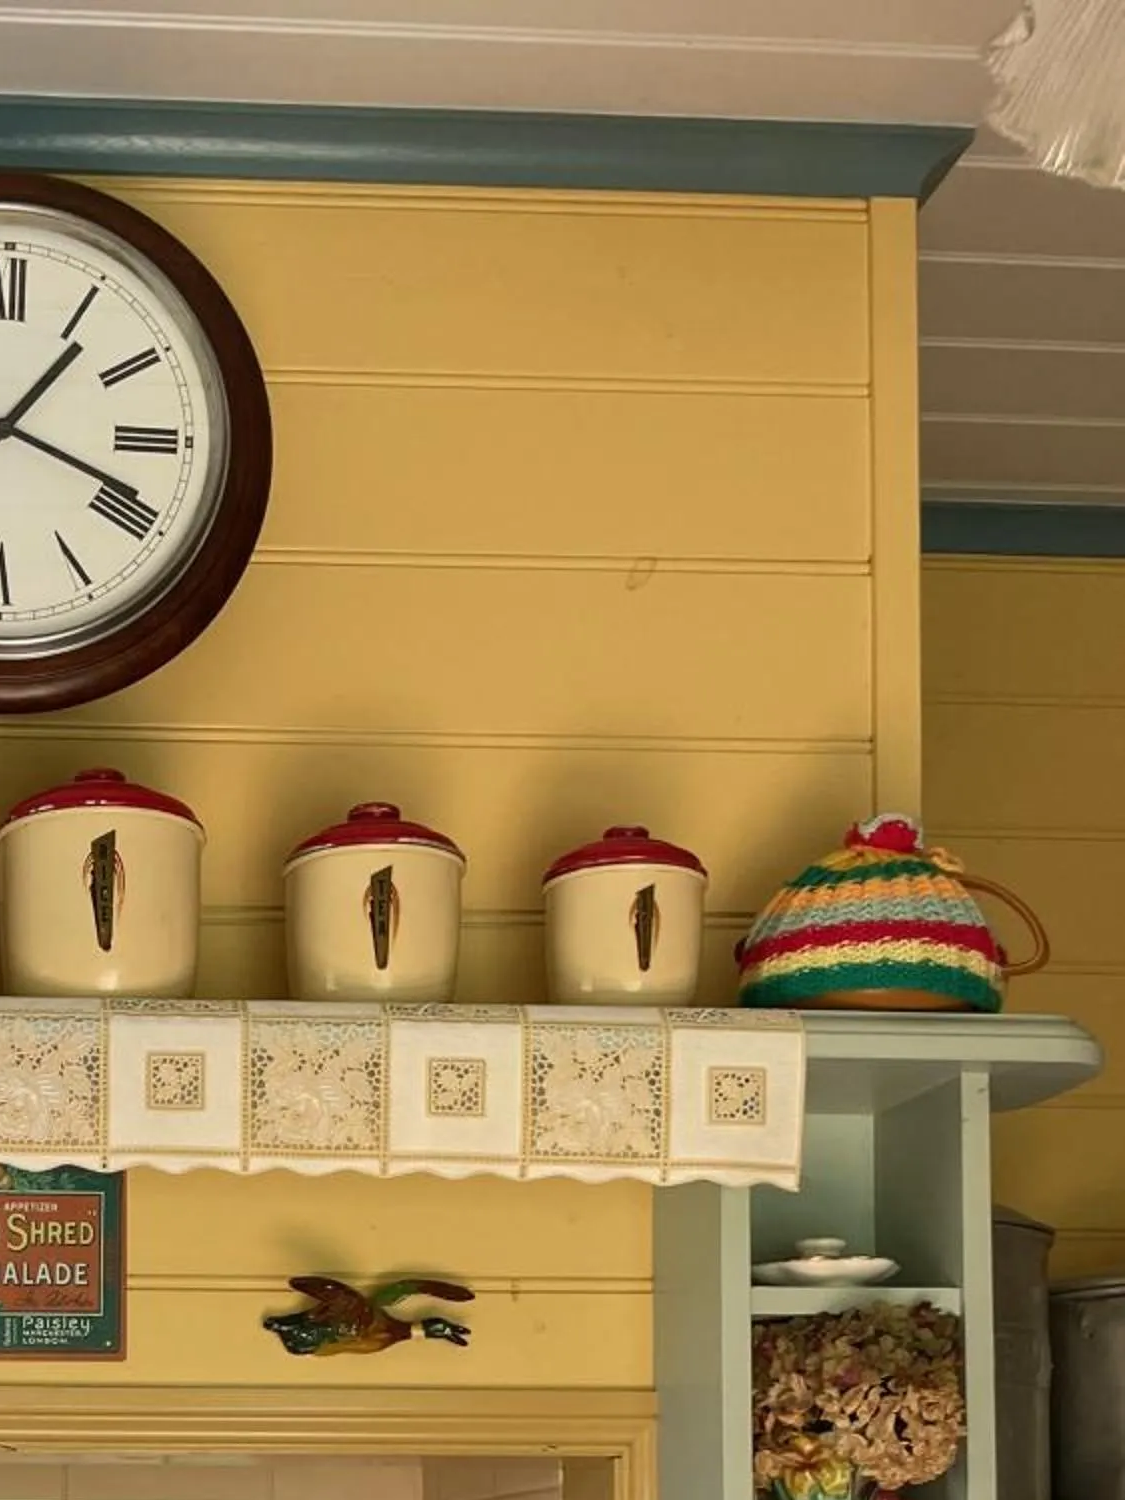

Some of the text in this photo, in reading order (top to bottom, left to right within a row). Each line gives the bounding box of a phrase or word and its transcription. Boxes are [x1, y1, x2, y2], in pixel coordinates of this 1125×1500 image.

[60, 284, 100, 340] I
[98, 346, 162, 388] II
[113, 424, 178, 455] III
[53, 528, 94, 592] V
